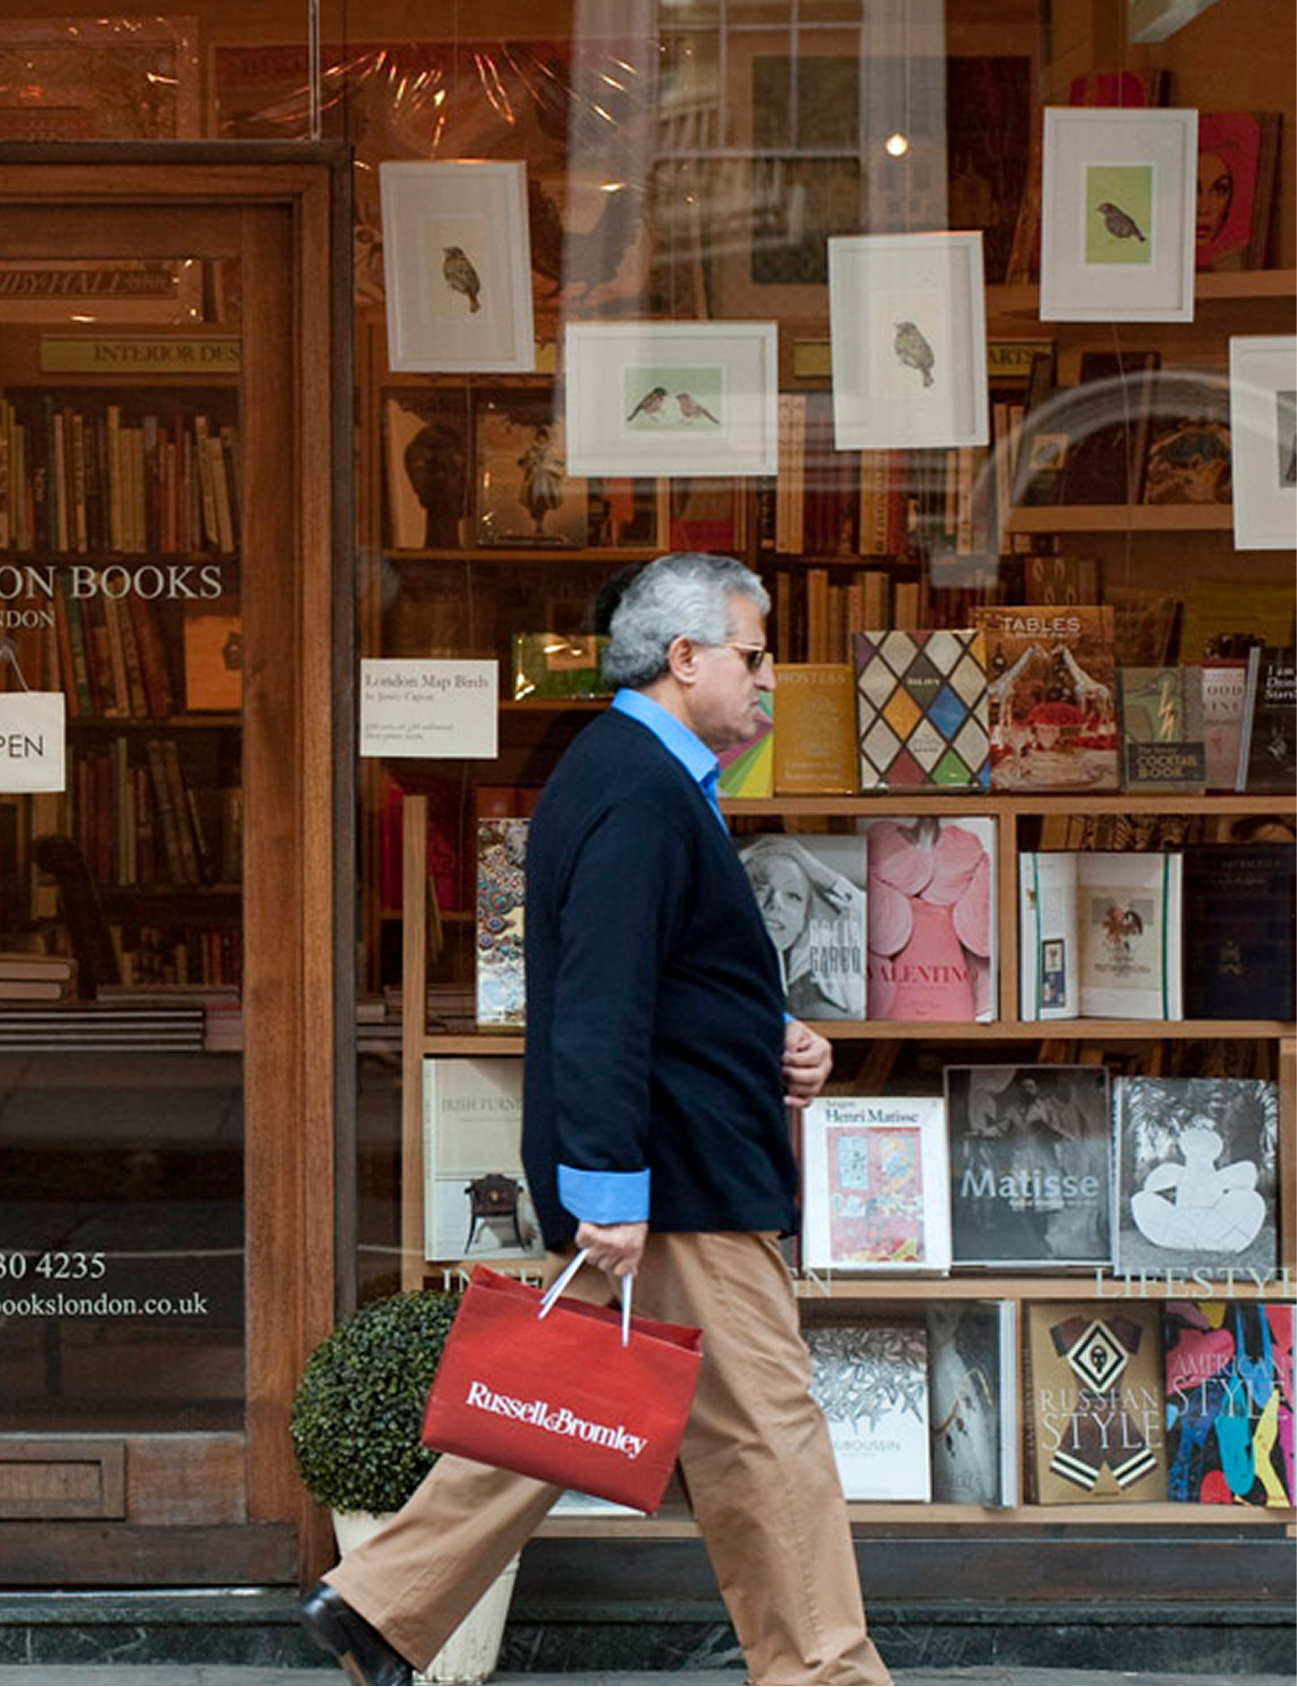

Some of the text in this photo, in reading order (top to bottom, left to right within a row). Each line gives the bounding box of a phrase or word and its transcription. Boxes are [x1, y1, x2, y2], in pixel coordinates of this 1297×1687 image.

[94, 344, 191, 362] INTERIOR
[70, 564, 223, 599] BOOKS
[1002, 617, 1082, 632] TABLES
[365, 675, 489, 692] London Map Birds
[1203, 701, 1241, 713] INE
[1137, 767, 1185, 779] BOOK
[867, 964, 979, 983] VALENTINO
[826, 1108, 919, 1123] Henri Matisse
[960, 1169, 1100, 1198] Matisse
[35, 1252, 106, 1280] 4235
[1172, 1352, 1288, 1378] AMERICAN
[1039, 1387, 1160, 1413] RUSSIAN
[1171, 1375, 1289, 1421] STYLE
[1041, 1411, 1162, 1451] STYLE
